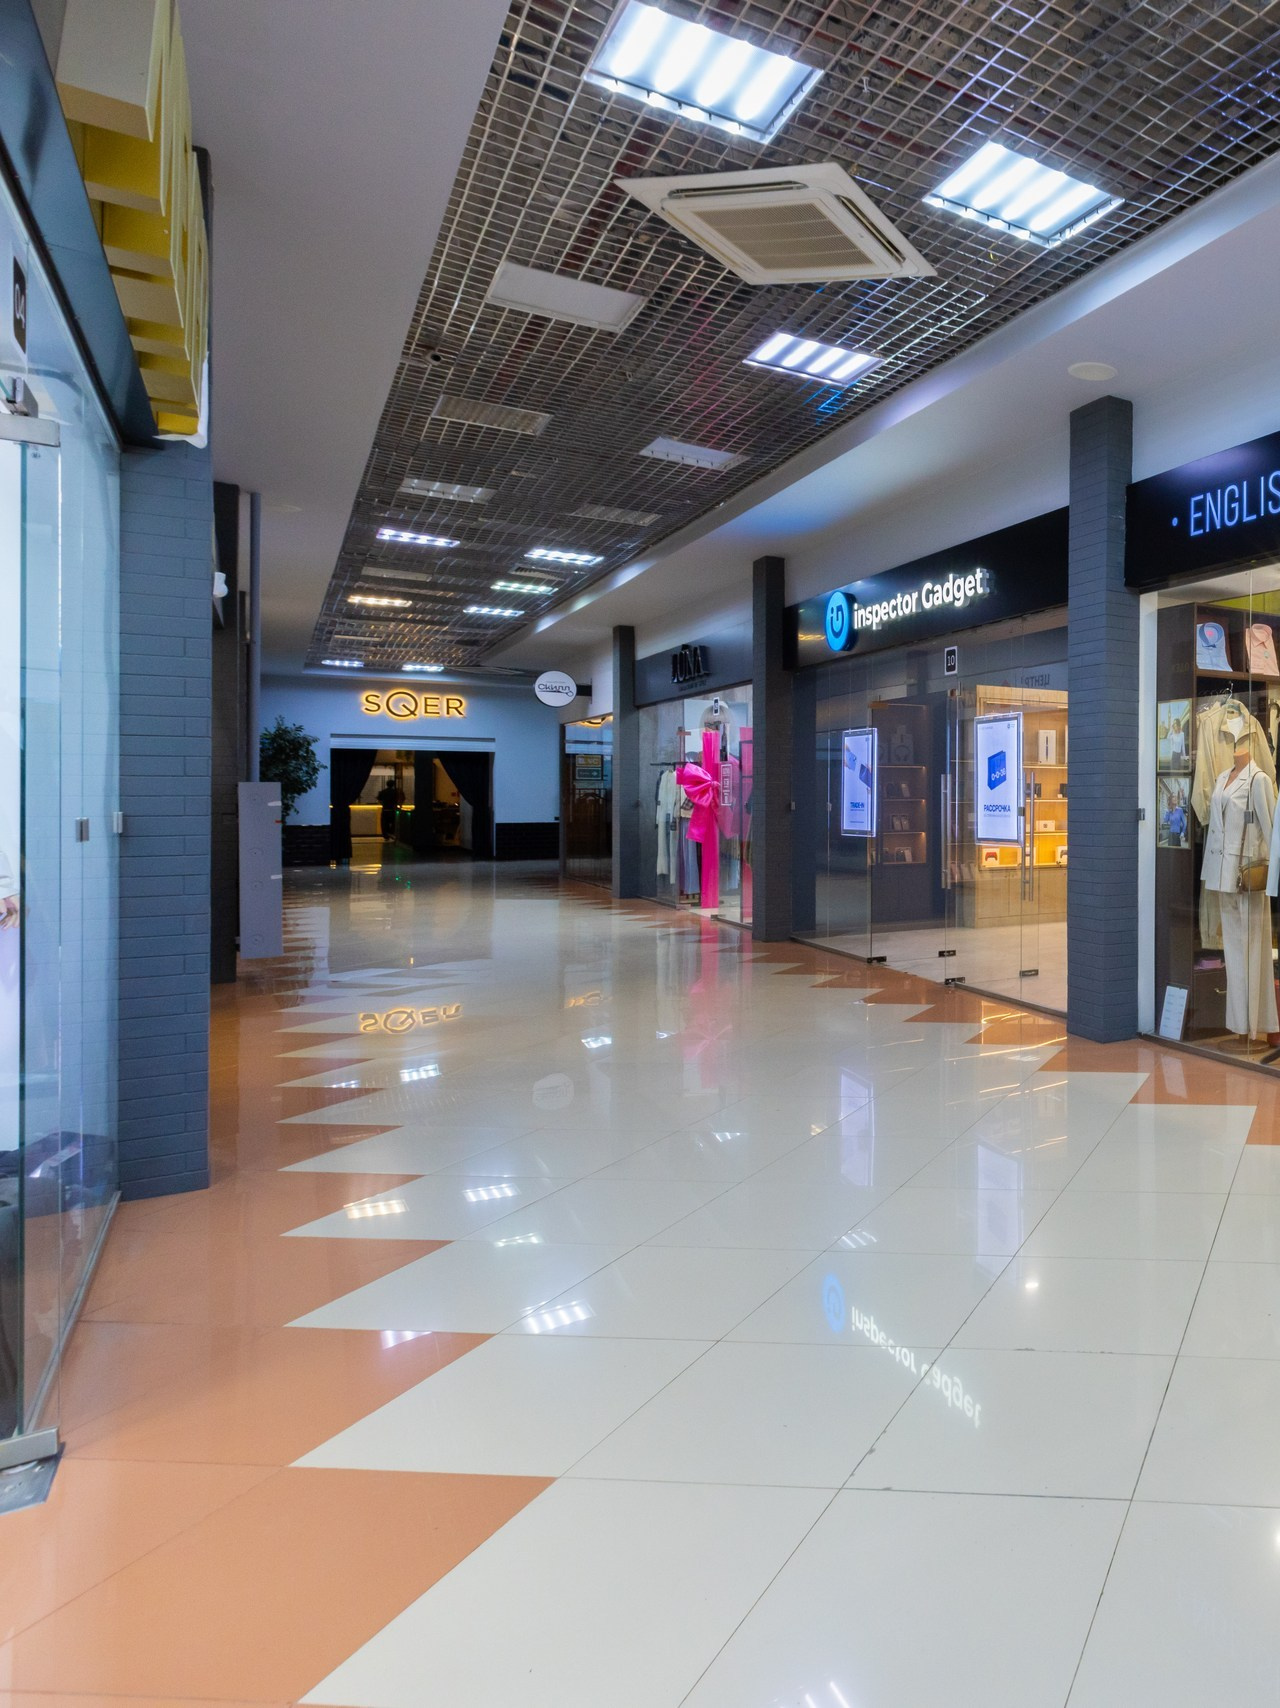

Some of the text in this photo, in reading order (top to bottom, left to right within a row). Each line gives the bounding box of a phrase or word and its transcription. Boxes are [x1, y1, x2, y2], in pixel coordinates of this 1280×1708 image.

[15, 283, 25, 329] 04
[854, 567, 984, 630] inspector Gadget
[947, 655, 955, 667] 10
[363, 690, 466, 718] SQER
[984, 804, 1011, 812] РАССРОЧКА
